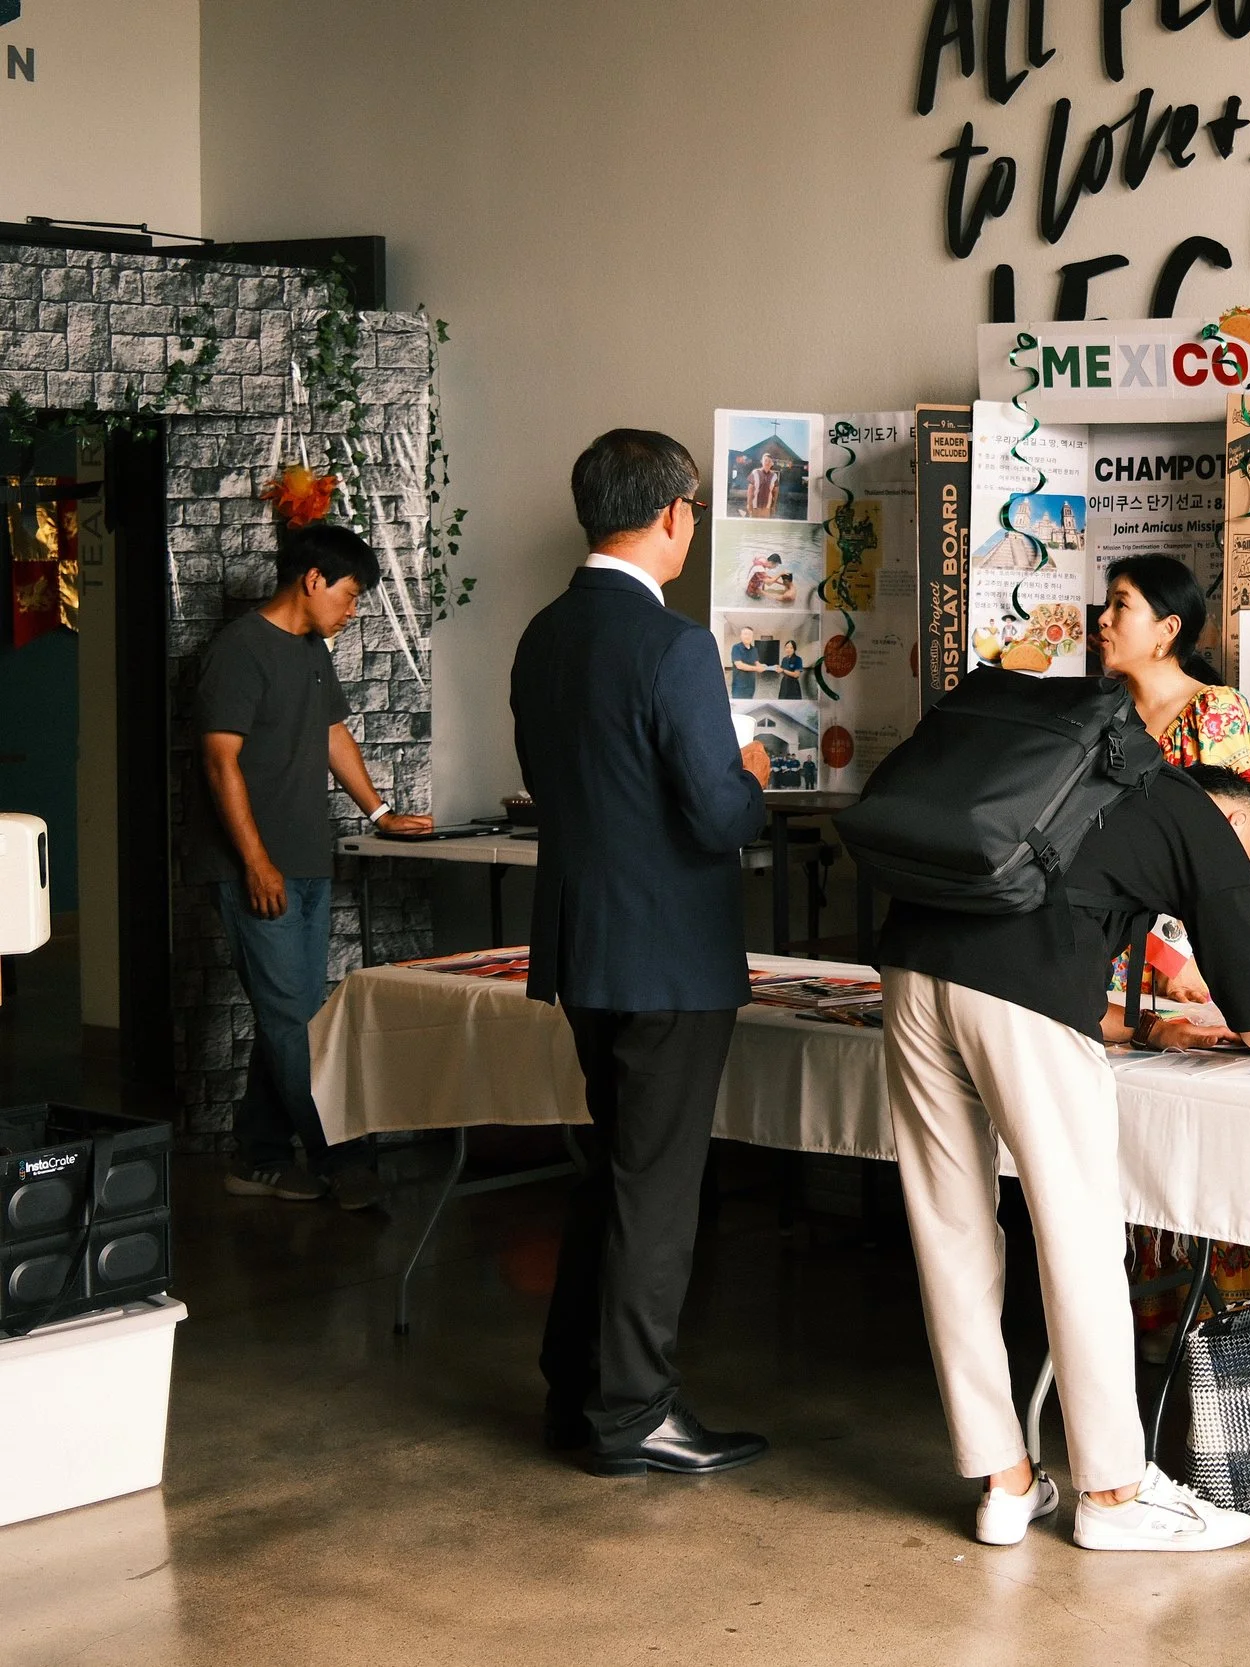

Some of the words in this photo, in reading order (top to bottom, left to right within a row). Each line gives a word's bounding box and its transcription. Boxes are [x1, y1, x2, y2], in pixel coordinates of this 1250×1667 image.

[941, 121, 1016, 258] to
[1042, 342, 1249, 389] MEXICO
[941, 420, 946, 428] 9
[933, 449, 967, 458] INCLUDED
[934, 437, 964, 447] HEADER
[1089, 495, 1143, 513] 아미쿠스
[1214, 498, 1225, 510] 8
[942, 484, 958, 576] BOARD
[1113, 522, 1139, 537] Joint
[1141, 520, 1183, 534] Amicus
[928, 580, 943, 636] Project
[942, 584, 959, 691] DISPLAY
